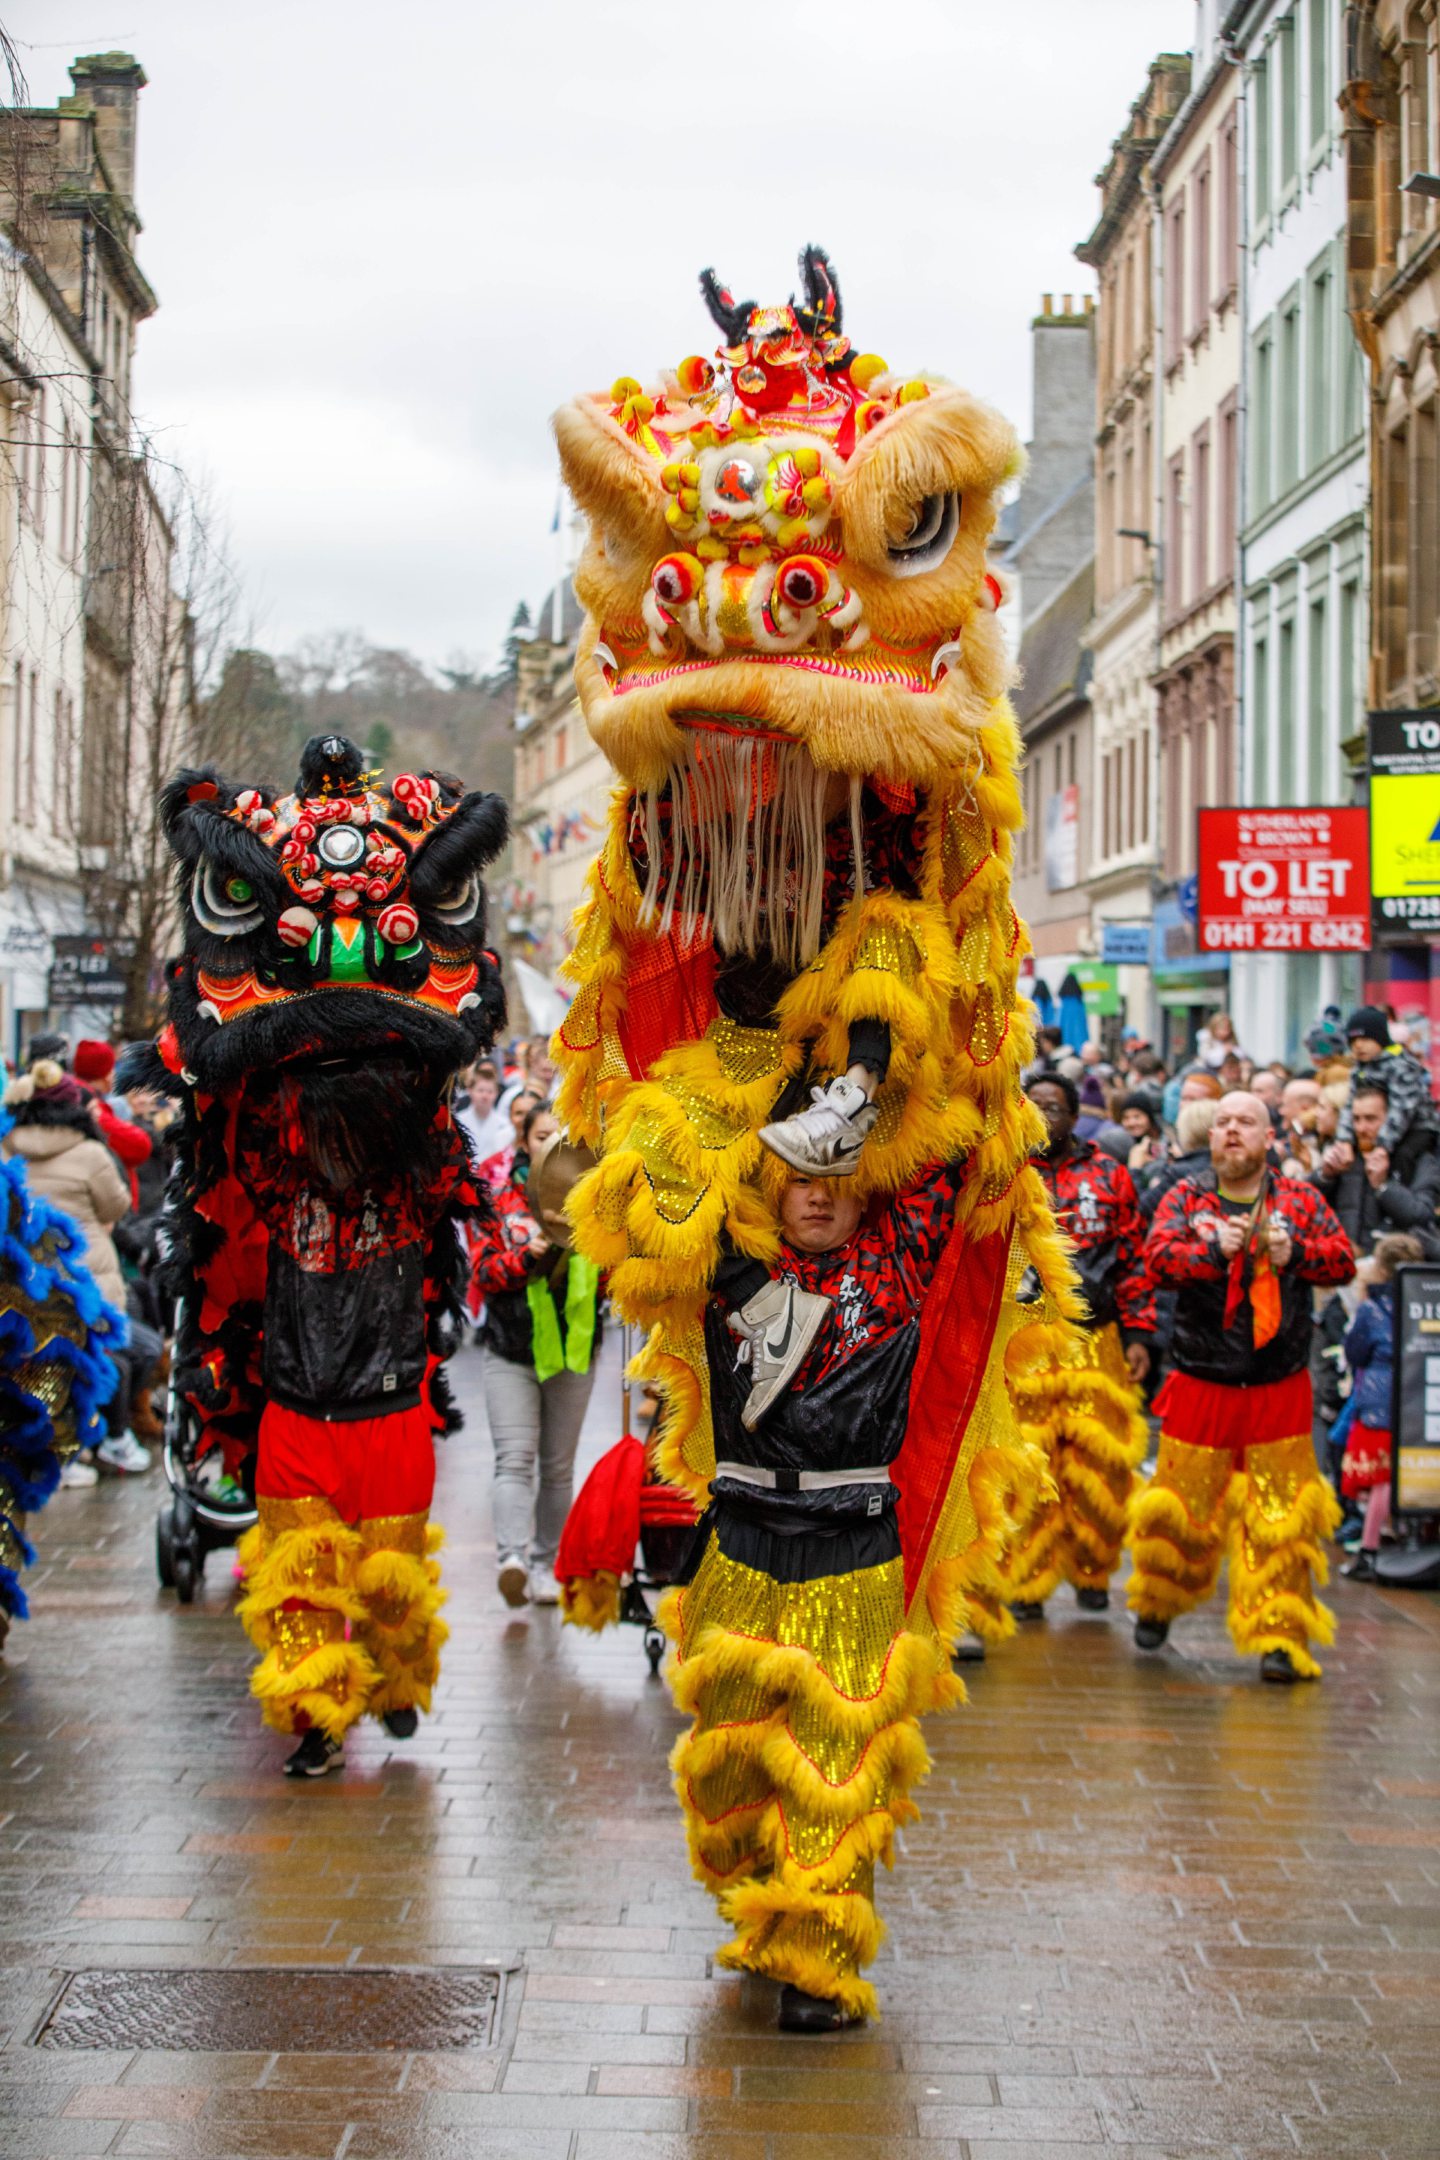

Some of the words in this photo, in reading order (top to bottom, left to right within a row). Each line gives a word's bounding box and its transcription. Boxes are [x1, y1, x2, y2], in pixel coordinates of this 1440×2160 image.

[1401, 720, 1440, 749] TO
[1256, 831, 1313, 845] BROWN
[1218, 860, 1278, 898] TO
[1288, 860, 1352, 898] LET
[1205, 923, 1255, 947] 0141
[1262, 923, 1302, 947] 221
